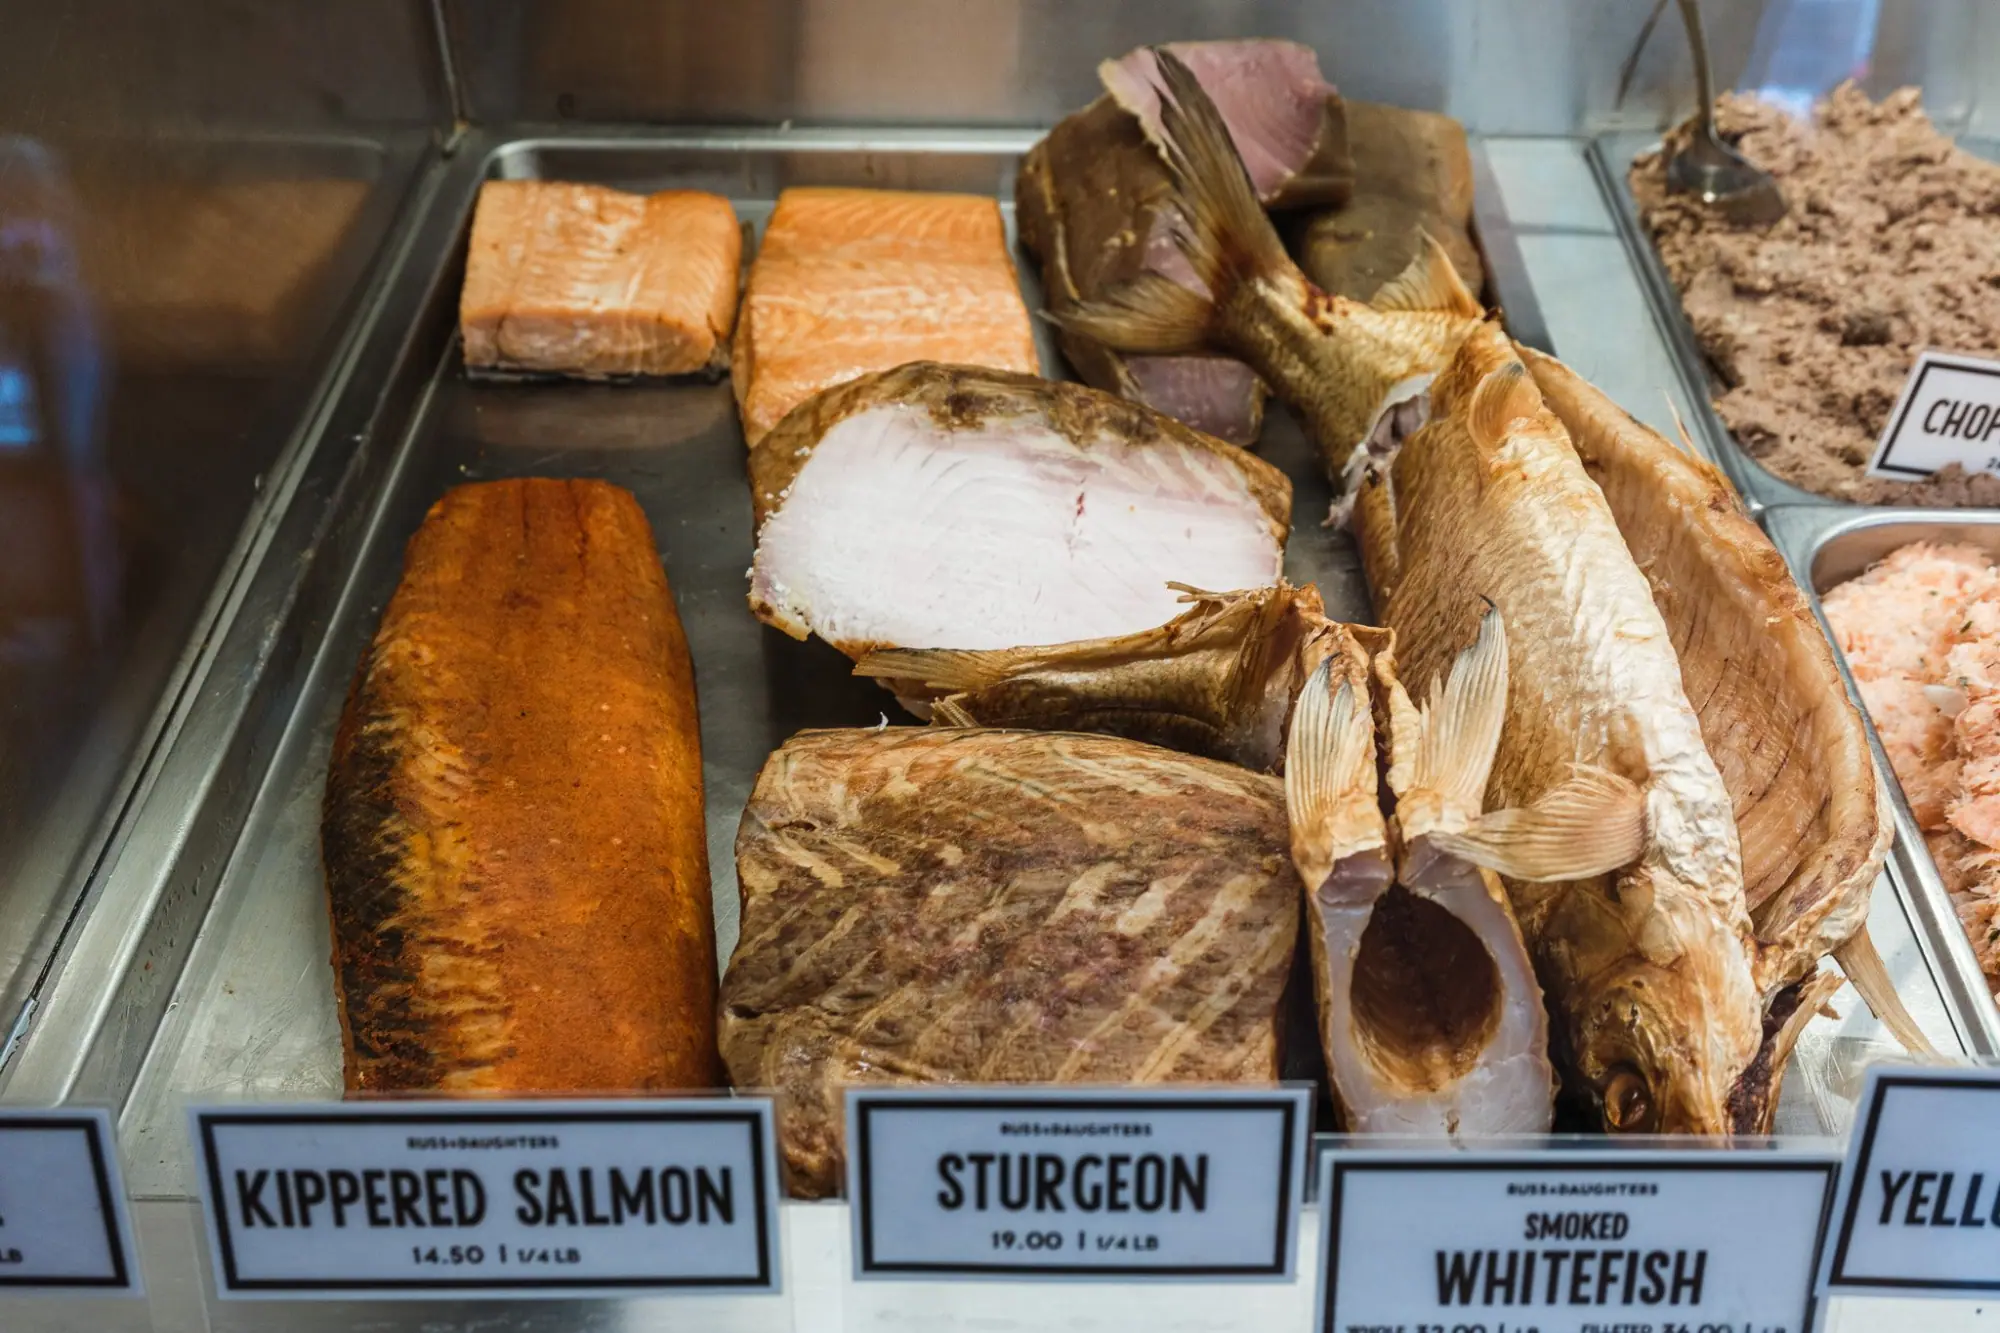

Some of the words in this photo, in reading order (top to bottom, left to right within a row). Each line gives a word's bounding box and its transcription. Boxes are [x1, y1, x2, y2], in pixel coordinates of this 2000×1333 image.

[234, 1168, 487, 1229] KIPPERED
[513, 1165, 735, 1227] SALMON
[936, 1152, 1209, 1213] STURGEON
[1878, 1169, 2000, 1229] YELL
[991, 1230, 1064, 1251] 19.00
[1132, 1234, 1160, 1252] LB
[1523, 1211, 1630, 1241] SMOKED
[412, 1245, 485, 1266] 14.50
[553, 1247, 581, 1265] LB
[1435, 1249, 1708, 1307] WHITEFISH
